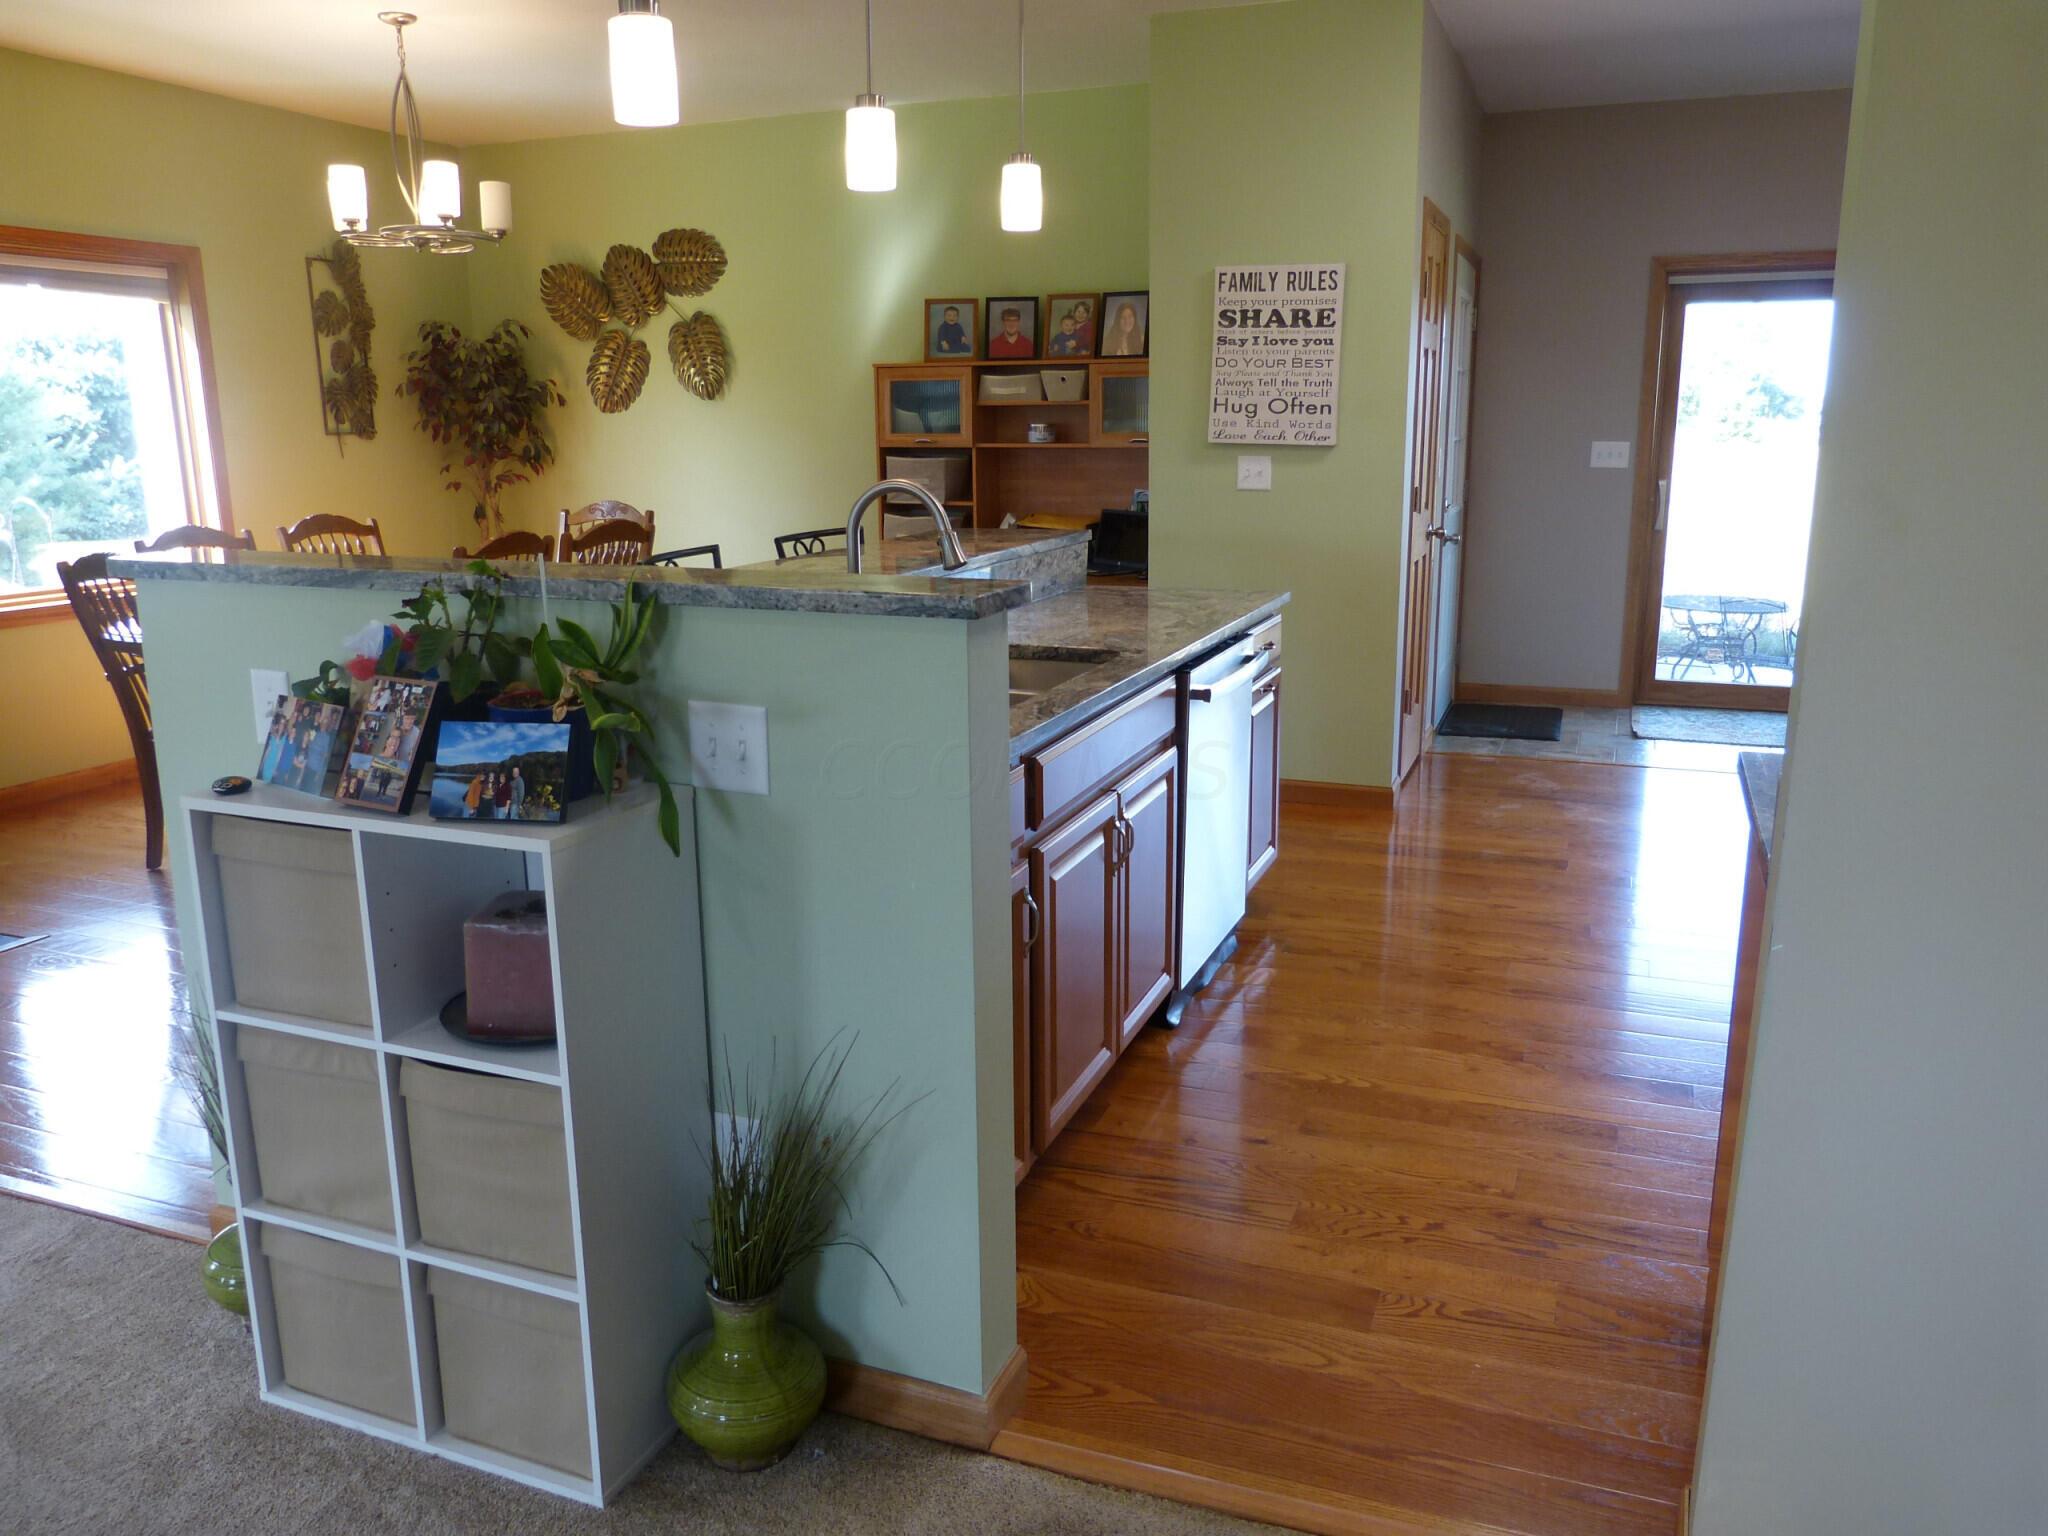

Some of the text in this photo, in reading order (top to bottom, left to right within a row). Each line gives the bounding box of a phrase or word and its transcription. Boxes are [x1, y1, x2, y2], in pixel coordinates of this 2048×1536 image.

[1218, 270, 1339, 293] FAMILY RULES
[1218, 296, 1337, 308] Keep your promises
[1217, 308, 1336, 329] SHARE
[1216, 336, 1335, 348] Say I love you
[1217, 347, 1335, 357] Listen to your parents
[1215, 378, 1333, 388] Always Tell the Truth
[1215, 387, 1254, 398] Laugh
[1275, 388, 1330, 398] Yourself
[1213, 396, 1332, 418] Hug Often
[1212, 418, 1332, 429] Use Kind Words
[1212, 429, 1331, 442] Love Each Other
